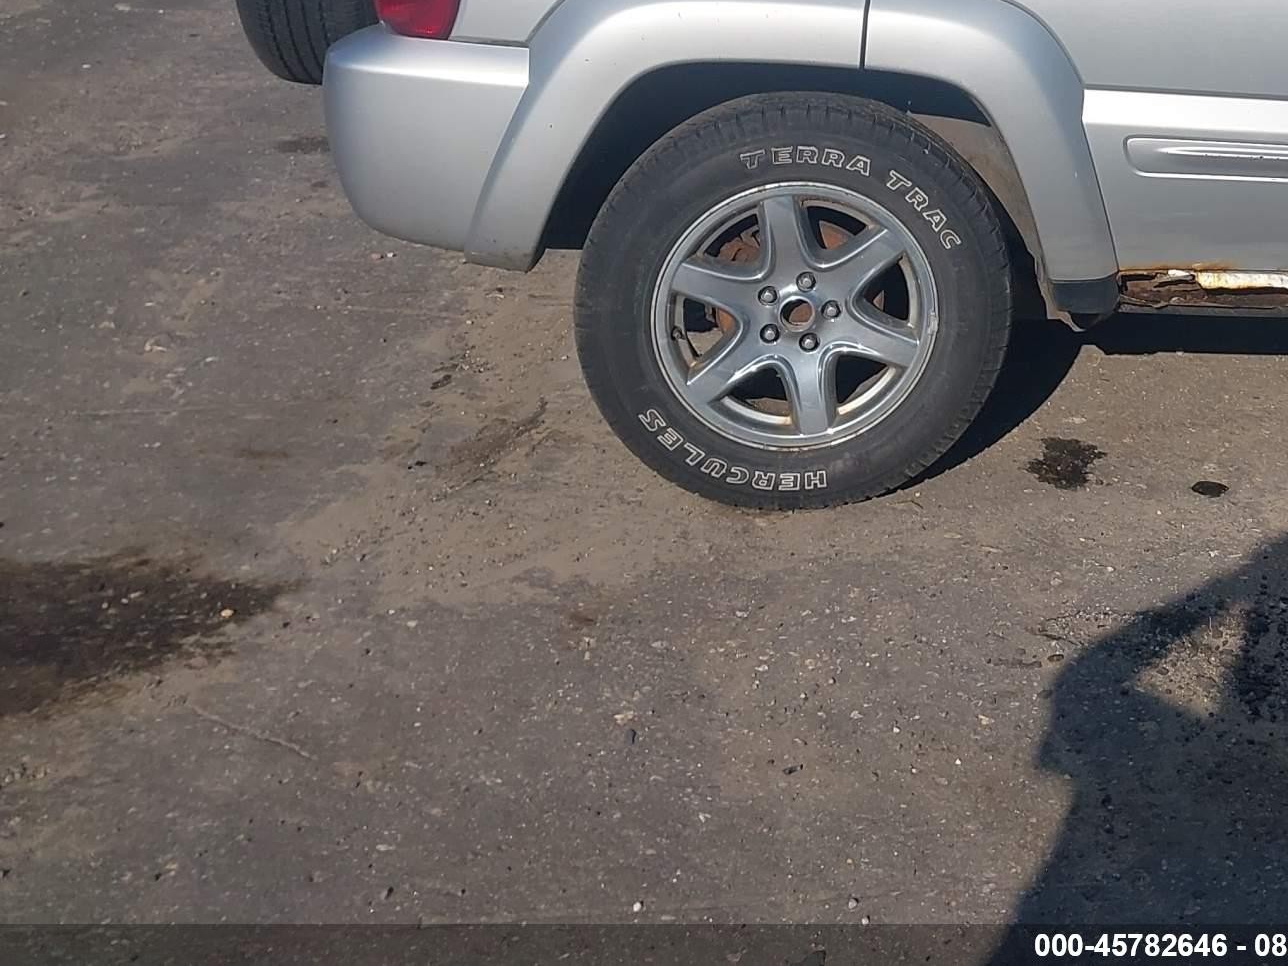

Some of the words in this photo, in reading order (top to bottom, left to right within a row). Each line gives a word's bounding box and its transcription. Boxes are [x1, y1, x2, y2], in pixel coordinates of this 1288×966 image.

[740, 145, 871, 177] TERRA
[886, 170, 961, 250] TRAC
[638, 408, 827, 491] HERCULES
